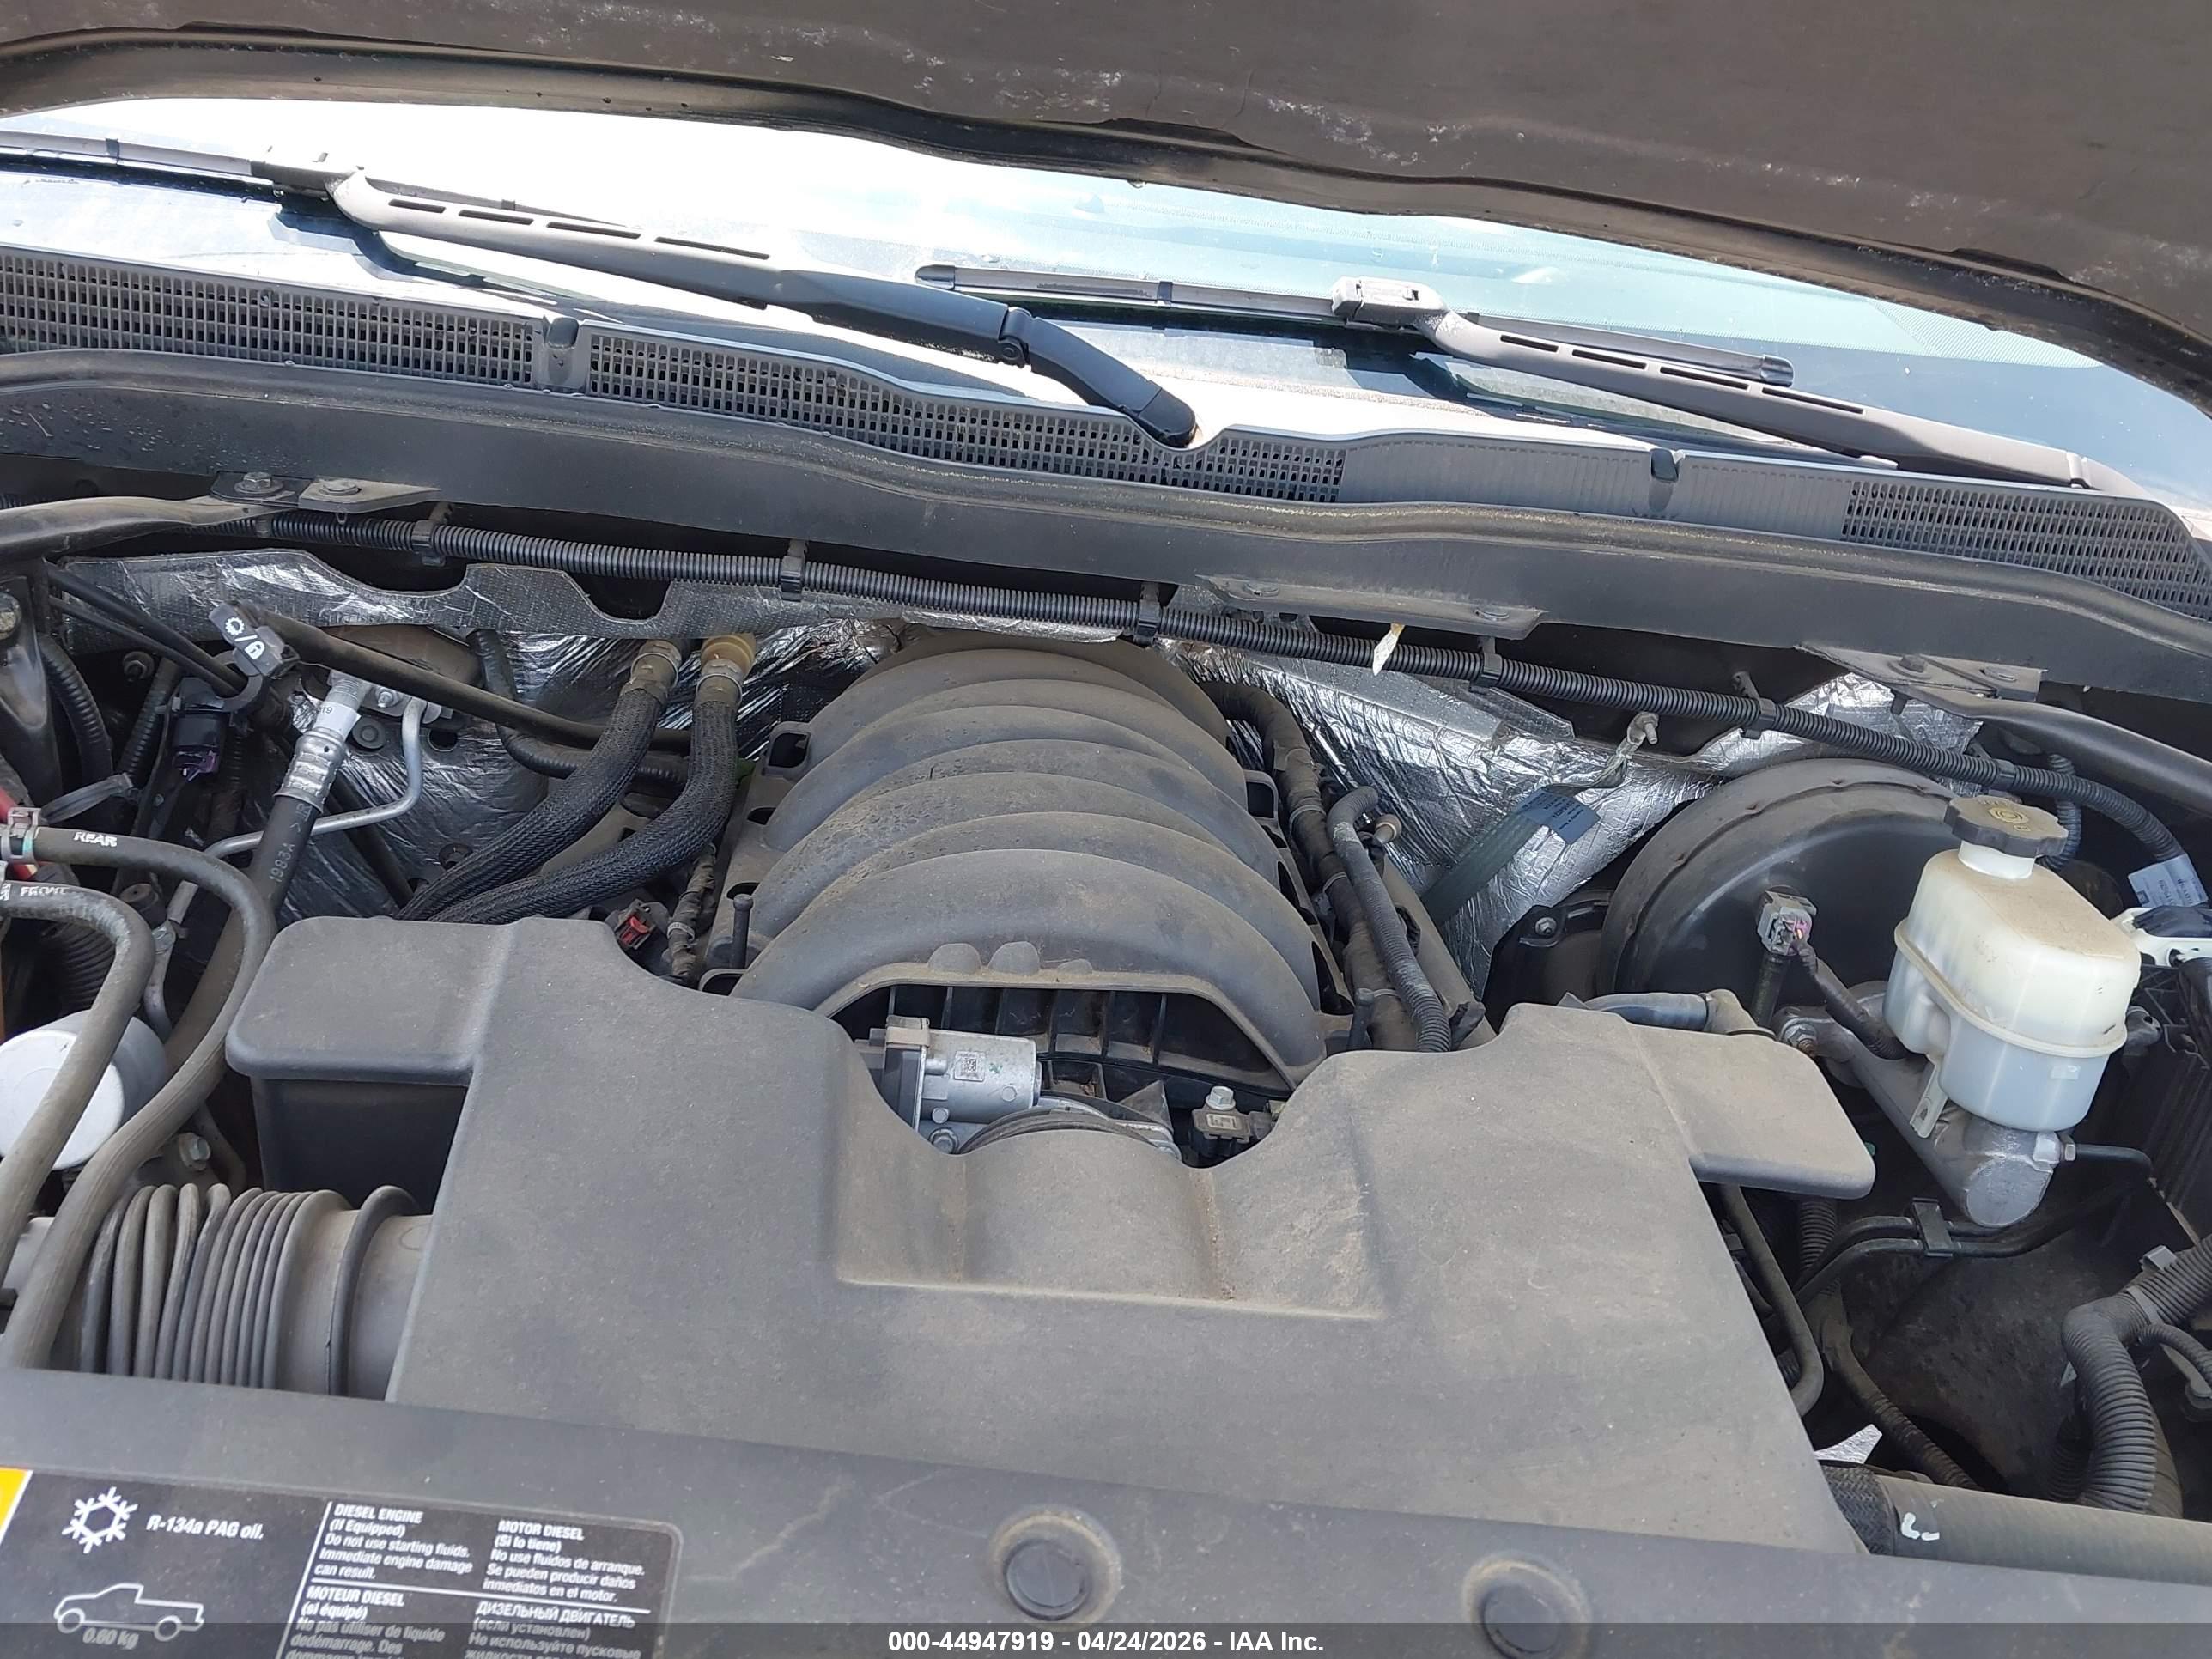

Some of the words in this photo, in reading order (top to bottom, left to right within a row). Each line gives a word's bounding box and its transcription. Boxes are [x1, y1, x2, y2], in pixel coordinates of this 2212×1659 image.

[73, 831, 118, 848] REAR
[269, 842, 295, 882] 1983A
[333, 1504, 375, 1519] DIESEL
[379, 1507, 424, 1523] ENGINE
[146, 1514, 204, 1535] R-134a
[204, 1519, 240, 1538] PAG
[329, 1518, 345, 1532] (If
[345, 1521, 405, 1538] Equipped)
[497, 1519, 542, 1535] MOTOR
[544, 1525, 585, 1540] DIESEL
[324, 1533, 341, 1546] Do
[343, 1535, 362, 1548] not
[365, 1538, 387, 1550] use
[388, 1540, 434, 1556] starting
[435, 1543, 470, 1558] fluids.
[494, 1534, 512, 1548] (Si
[514, 1536, 526, 1549] lo
[527, 1538, 562, 1554] tiene)
[314, 1565, 337, 1576] can
[338, 1566, 376, 1579] result.
[319, 1547, 381, 1565] Immediate
[383, 1554, 424, 1569] engine
[425, 1557, 473, 1576] damage
[489, 1548, 507, 1561] No
[509, 1552, 531, 1564] use
[532, 1553, 572, 1568] fluidos
[574, 1557, 589, 1570] de
[590, 1560, 645, 1577] arranque.
[486, 1563, 503, 1576] Se
[504, 1565, 548, 1580] pueden
[550, 1571, 599, 1585] producir
[306, 1585, 360, 1603] MOTEUR
[362, 1592, 405, 1607] DIESEL
[483, 1577, 547, 1596] inmediatos
[549, 1585, 564, 1597] en
[566, 1585, 579, 1598] el
[580, 1588, 618, 1603] motor.
[301, 1601, 319, 1616] (si
[320, 1604, 368, 1620] équipé)
[475, 1601, 558, 1620] ДИЗЕЛЬНЫЙ
[559, 1607, 636, 1629] ДВИГАТЕЛЬ
[116, 1628, 140, 1650] kg
[295, 1617, 314, 1631] Ne
[315, 1620, 339, 1634] pas
[341, 1621, 383, 1638] utiliser
[385, 1624, 401, 1638] de
[403, 1626, 446, 1642] liquide
[472, 1618, 509, 1632] (если
[511, 1621, 592, 1641] установлен)
[378, 1639, 404, 1654] Des
[468, 1632, 487, 1646] Не
[489, 1635, 574, 1654] используйте
[576, 1643, 641, 1659] пусковые
